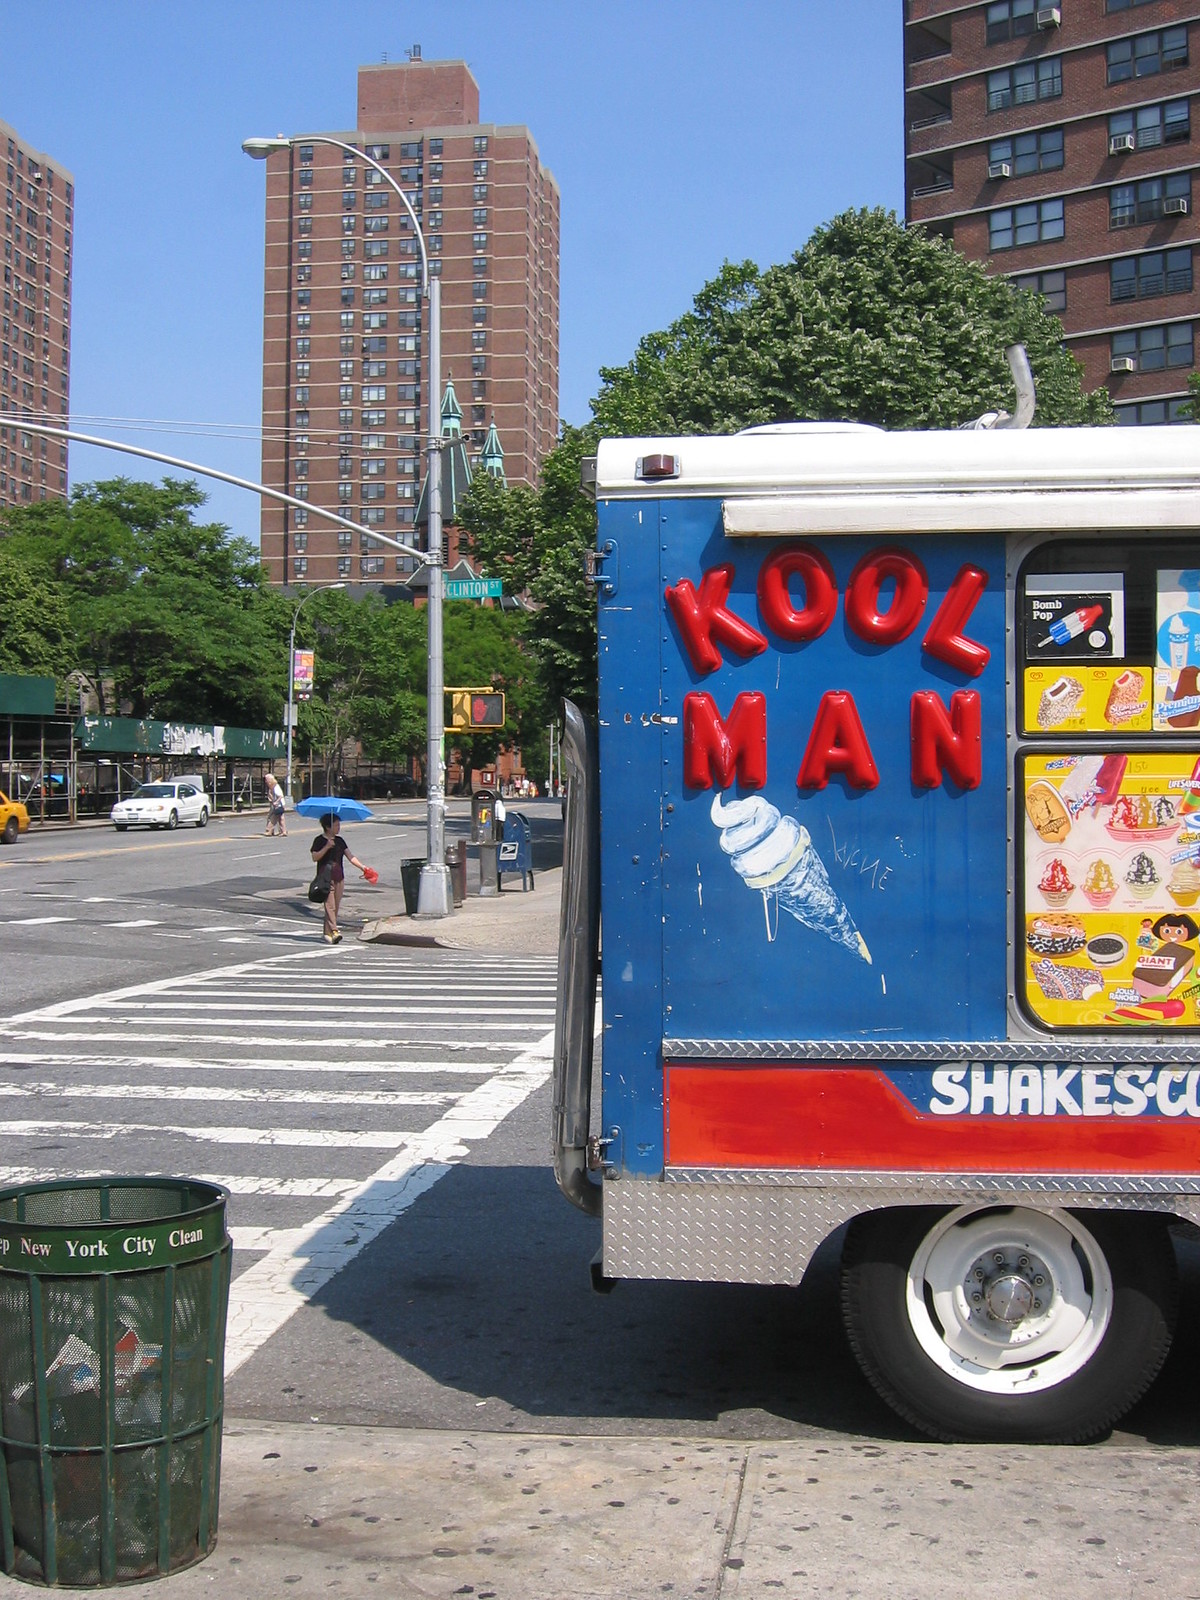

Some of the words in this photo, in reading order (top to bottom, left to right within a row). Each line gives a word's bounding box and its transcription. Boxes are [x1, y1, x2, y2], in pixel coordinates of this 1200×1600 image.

[447, 582, 488, 596] CLINTON
[490, 581, 500, 589] ST
[664, 543, 991, 677] KOOL
[1032, 600, 1062, 610] Bomb
[1032, 611, 1053, 621] Pop
[683, 690, 982, 790] MAN
[1137, 956, 1173, 965] GIANT
[1116, 987, 1136, 996] JOLLY
[1109, 993, 1142, 1003] RANCHER
[21, 1237, 52, 1256] New
[66, 1239, 109, 1257] York
[123, 1236, 157, 1255] City
[169, 1228, 203, 1248] Clean
